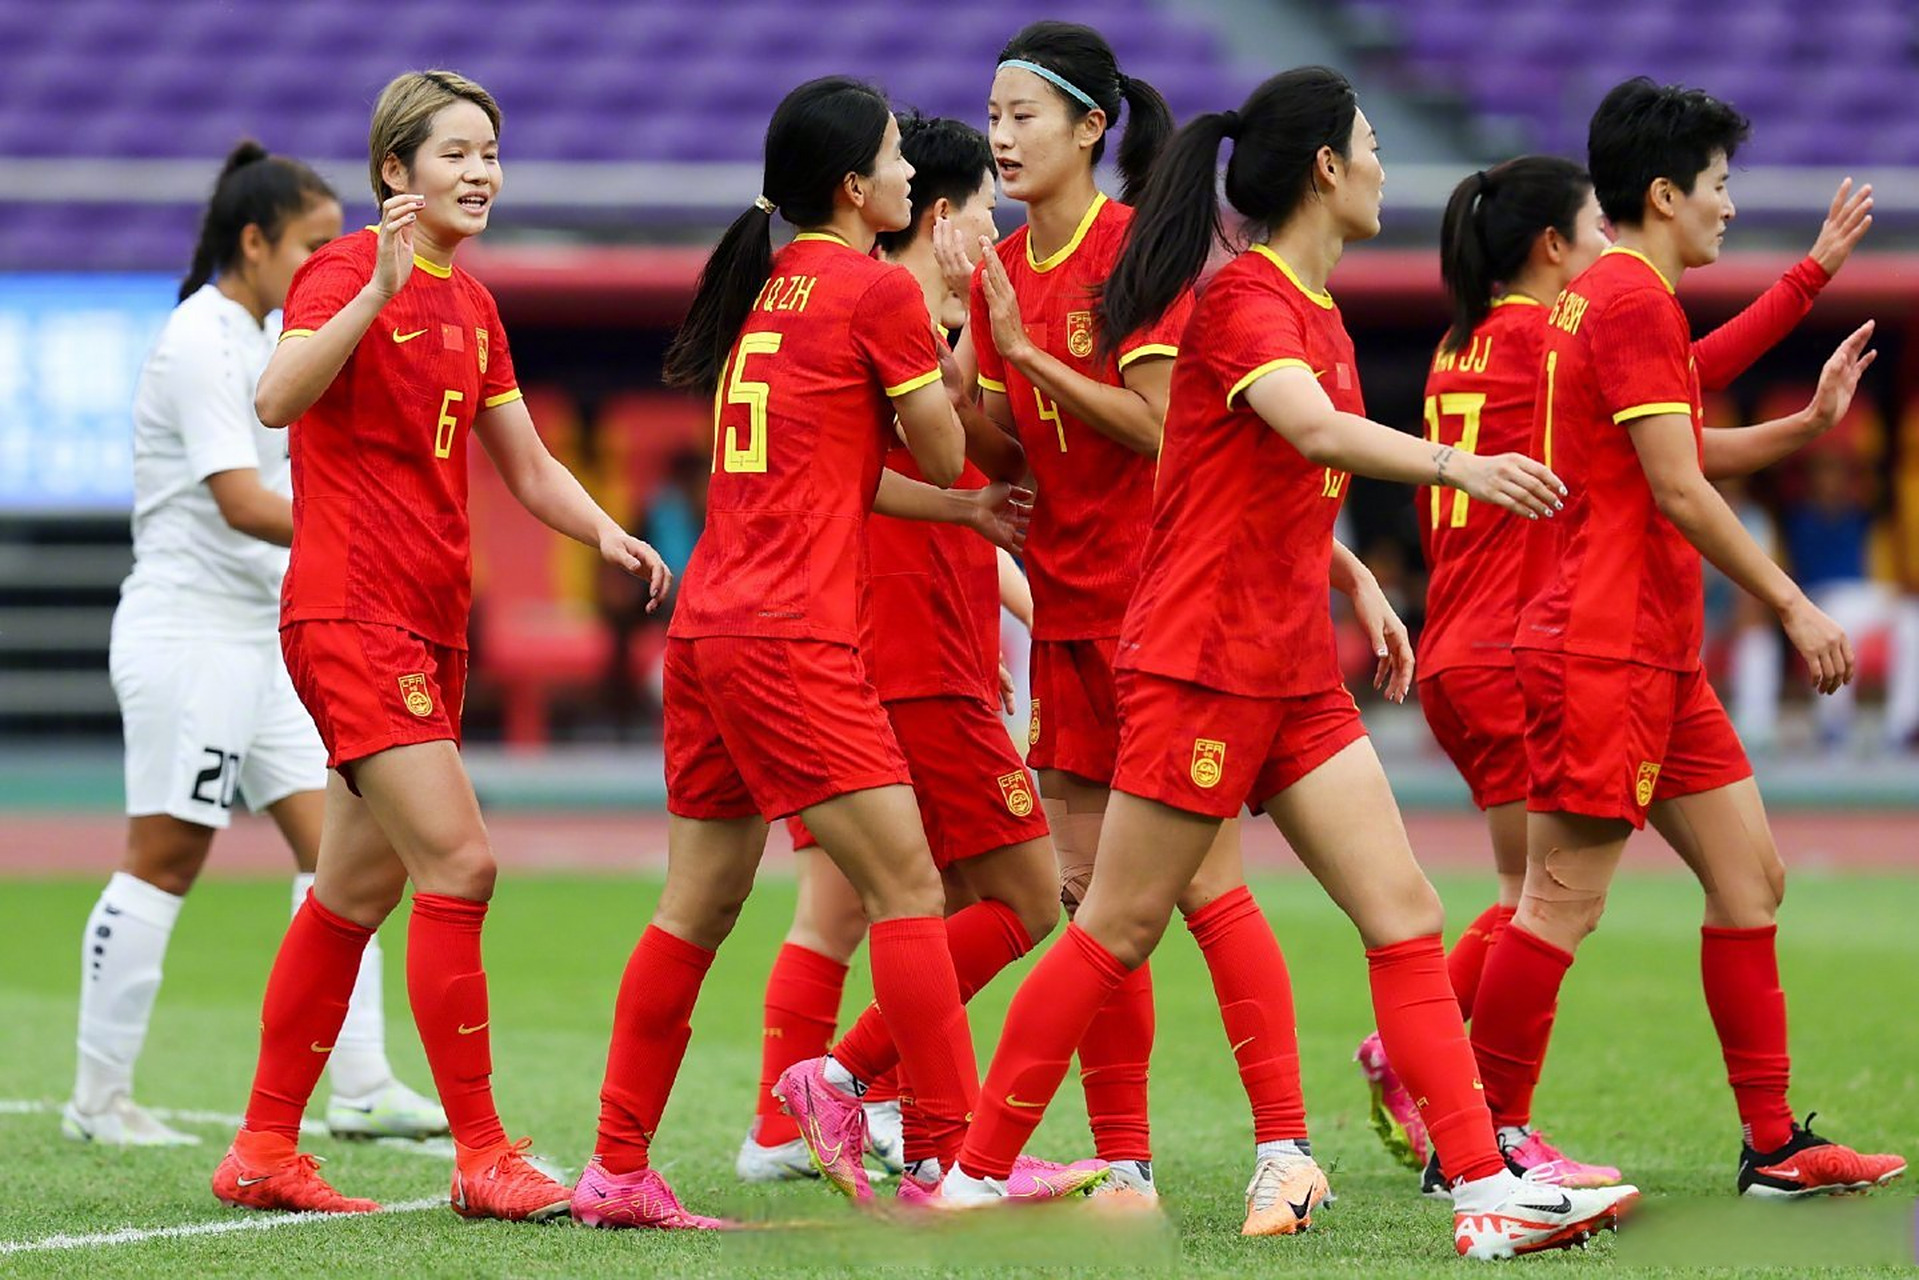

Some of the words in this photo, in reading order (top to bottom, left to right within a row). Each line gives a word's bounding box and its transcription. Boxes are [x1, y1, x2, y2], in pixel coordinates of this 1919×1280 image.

[434, 389, 464, 459] 6
[1033, 386, 1068, 453] 4
[1424, 393, 1487, 531] 17
[191, 747, 239, 809] 20
